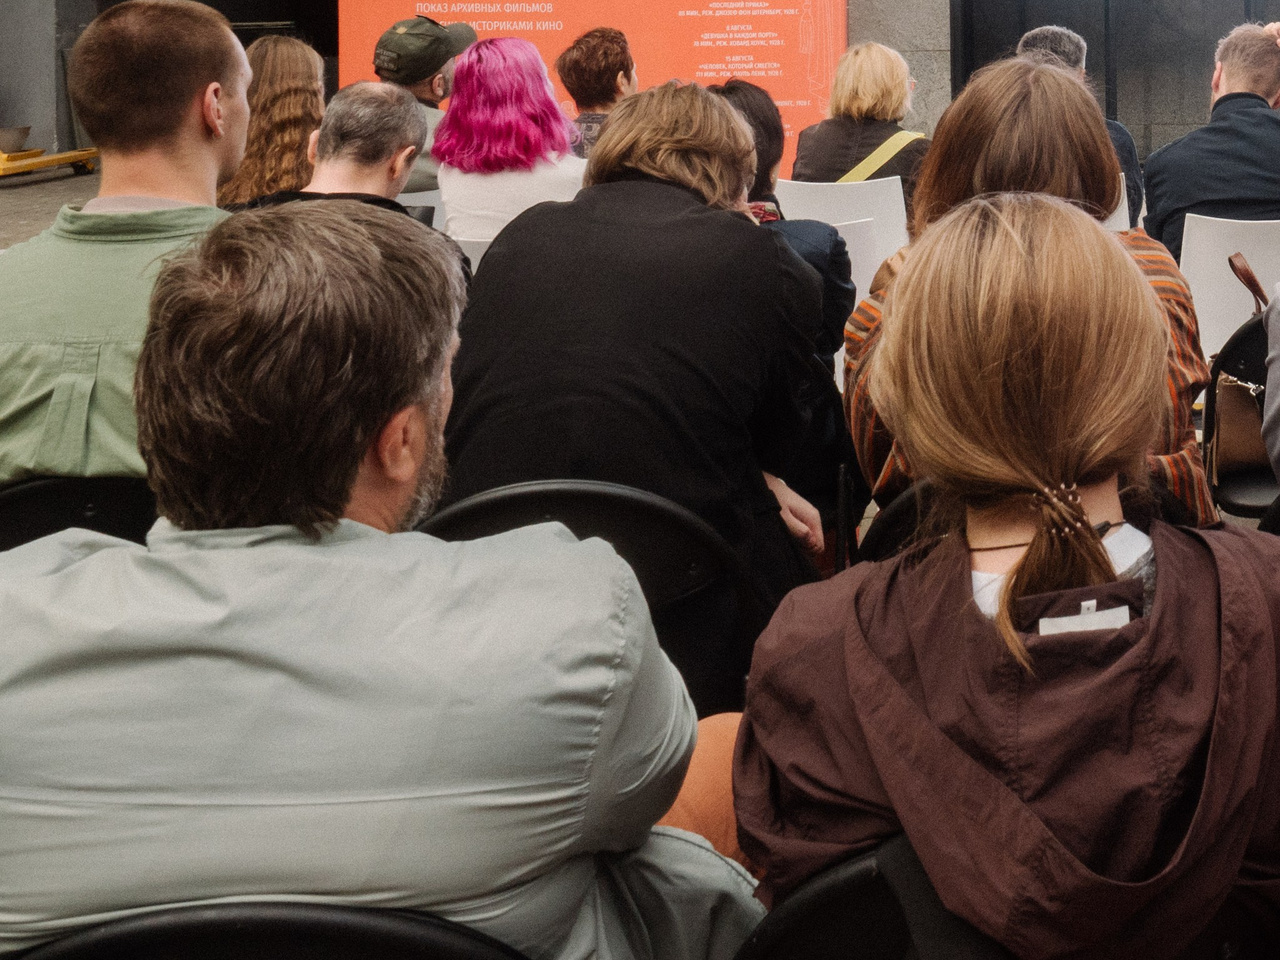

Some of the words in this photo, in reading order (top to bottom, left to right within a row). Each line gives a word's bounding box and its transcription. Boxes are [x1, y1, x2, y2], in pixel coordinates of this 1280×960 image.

[416, 3, 448, 13] ПОКАЗ
[451, 3, 501, 13] АРХИВНЫХ
[504, 3, 553, 13] ФИЛЬМОВ
[536, 21, 563, 31] КИНО
